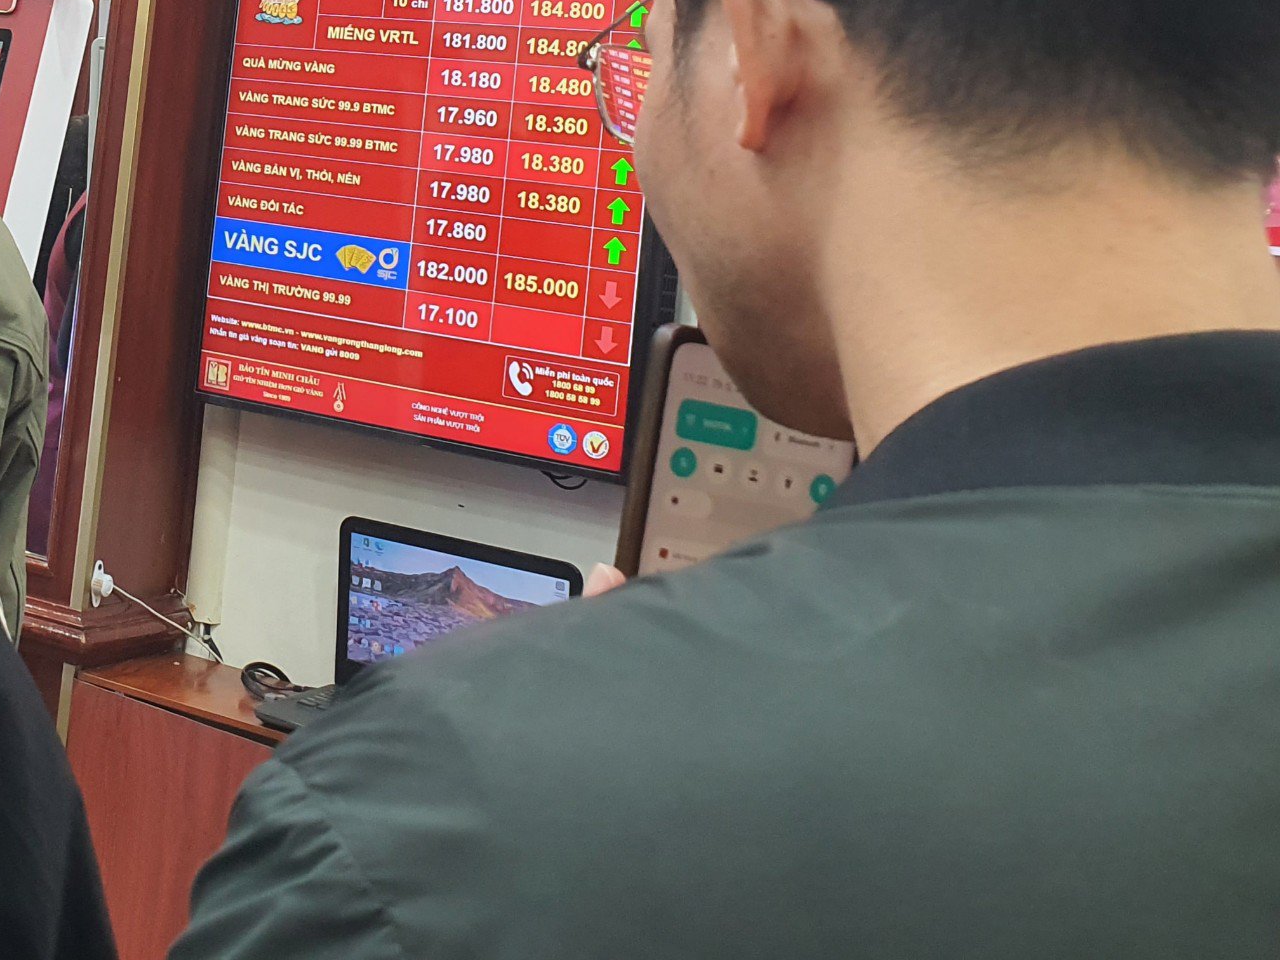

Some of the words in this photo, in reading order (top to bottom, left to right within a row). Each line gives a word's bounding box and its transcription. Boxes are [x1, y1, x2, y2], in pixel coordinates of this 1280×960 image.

[530, 0, 605, 20] 184.800
[327, 24, 376, 42] MIẾNG
[379, 29, 419, 45] VRTL
[442, 32, 507, 51] 181.800
[242, 57, 266, 69] QUÀ
[268, 57, 301, 71] MỪNG
[304, 61, 335, 74] VÀNG
[440, 69, 502, 89] 18.180
[529, 76, 592, 97] 18.480
[239, 90, 269, 103] VÀNG
[272, 94, 309, 107] TRANG
[311, 96, 335, 110] SỨC
[338, 101, 360, 112] 99.9
[362, 103, 396, 115] BTMC
[437, 106, 498, 127] 17.960
[525, 114, 588, 135] 18.360
[235, 124, 265, 138] VÀNG
[268, 129, 305, 143] TRANG
[308, 132, 332, 145] SỨC
[334, 137, 362, 149] 99.99
[365, 139, 398, 153] BTMC
[433, 143, 494, 165] 17.980
[521, 153, 585, 175] 18.380
[231, 159, 262, 173] VÀNG
[264, 162, 287, 177] BẢN
[289, 167, 303, 181] VỊ,
[306, 168, 334, 183] THỎI,
[337, 170, 361, 185] NÉN
[429, 180, 490, 203] 17.980
[517, 191, 581, 214] 18.380
[228, 195, 258, 209] VÀNG
[260, 198, 279, 212] ĐỐI
[282, 201, 305, 216] TÁC
[426, 218, 487, 242] 17.860
[224, 229, 279, 254] VÀNG
[284, 240, 323, 261] SJC
[417, 260, 488, 286] 182.000
[504, 272, 579, 299] 185.000
[210, 314, 239, 325] Website:
[220, 274, 250, 289] VÀNG
[252, 280, 269, 294] THỊ
[272, 282, 321, 300] TRƯỜNG
[322, 291, 352, 305] 99.99
[418, 303, 479, 328] 17.100
[271, 370, 294, 381] MINH
